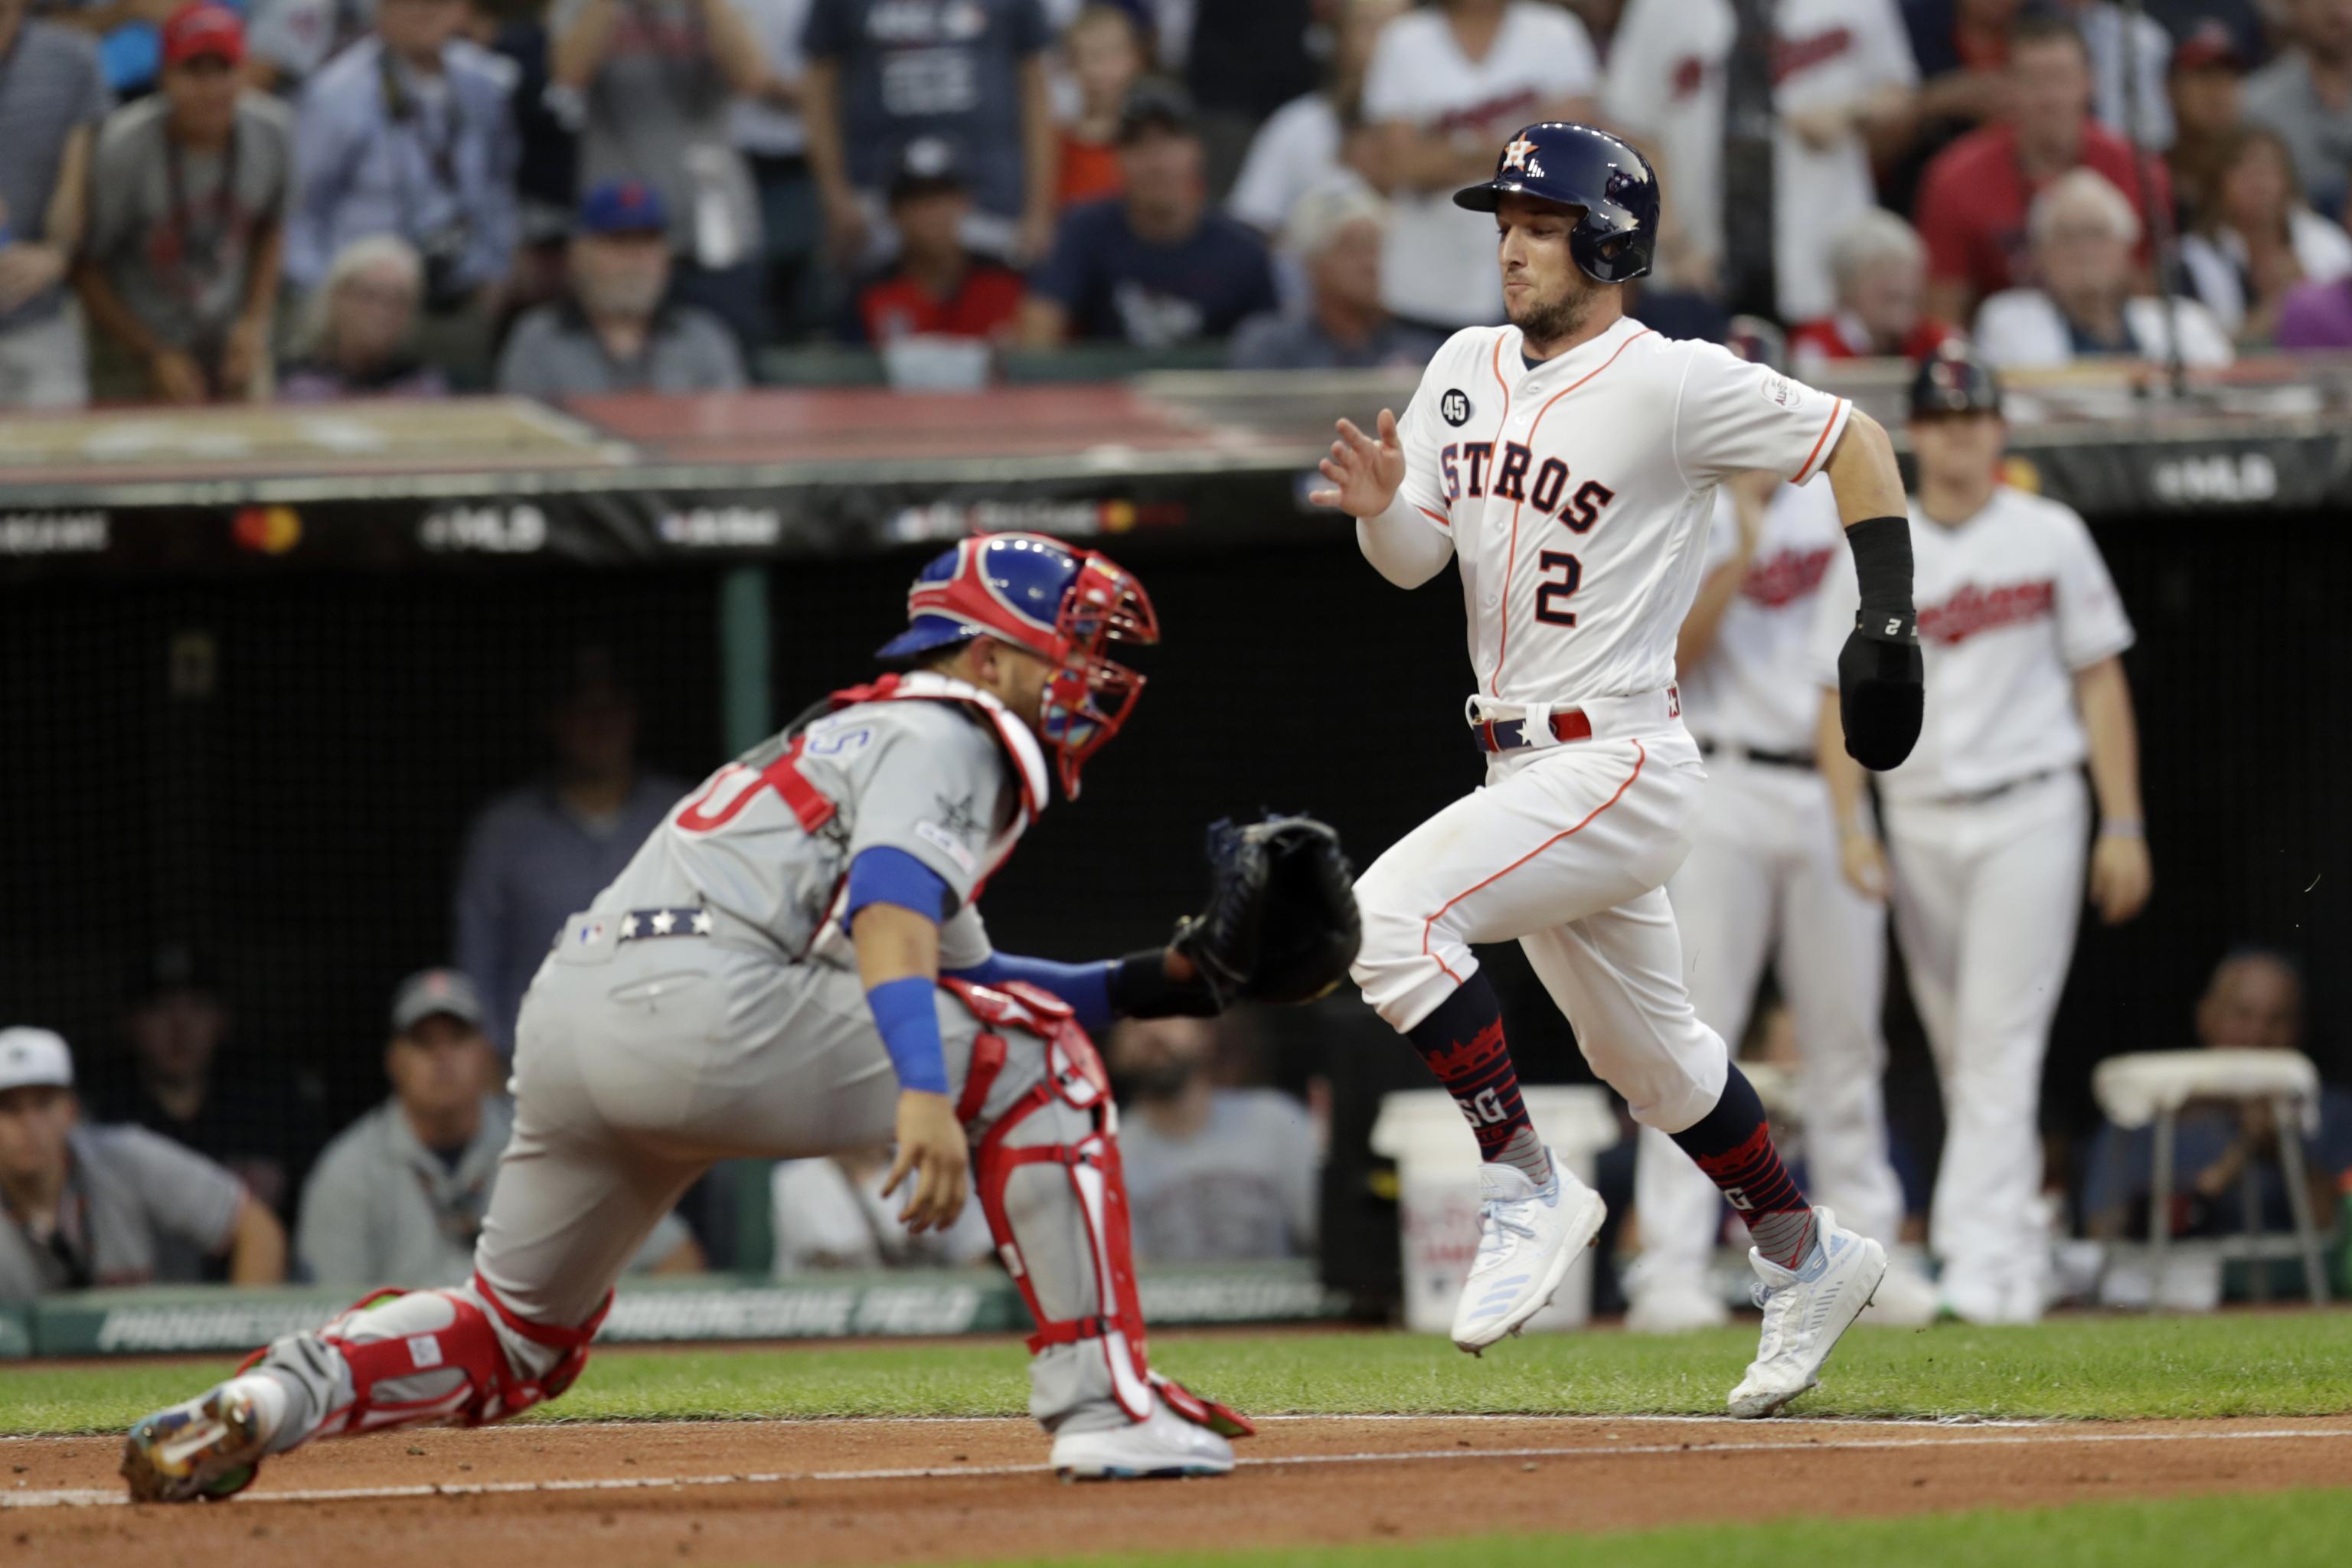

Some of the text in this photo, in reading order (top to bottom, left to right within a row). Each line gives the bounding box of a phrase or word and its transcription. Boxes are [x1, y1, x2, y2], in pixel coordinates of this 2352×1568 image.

[1503, 141, 1532, 167] H
[1442, 394, 1466, 422] 45
[1440, 439, 1615, 535] STROS
[1534, 548, 1583, 629] 2
